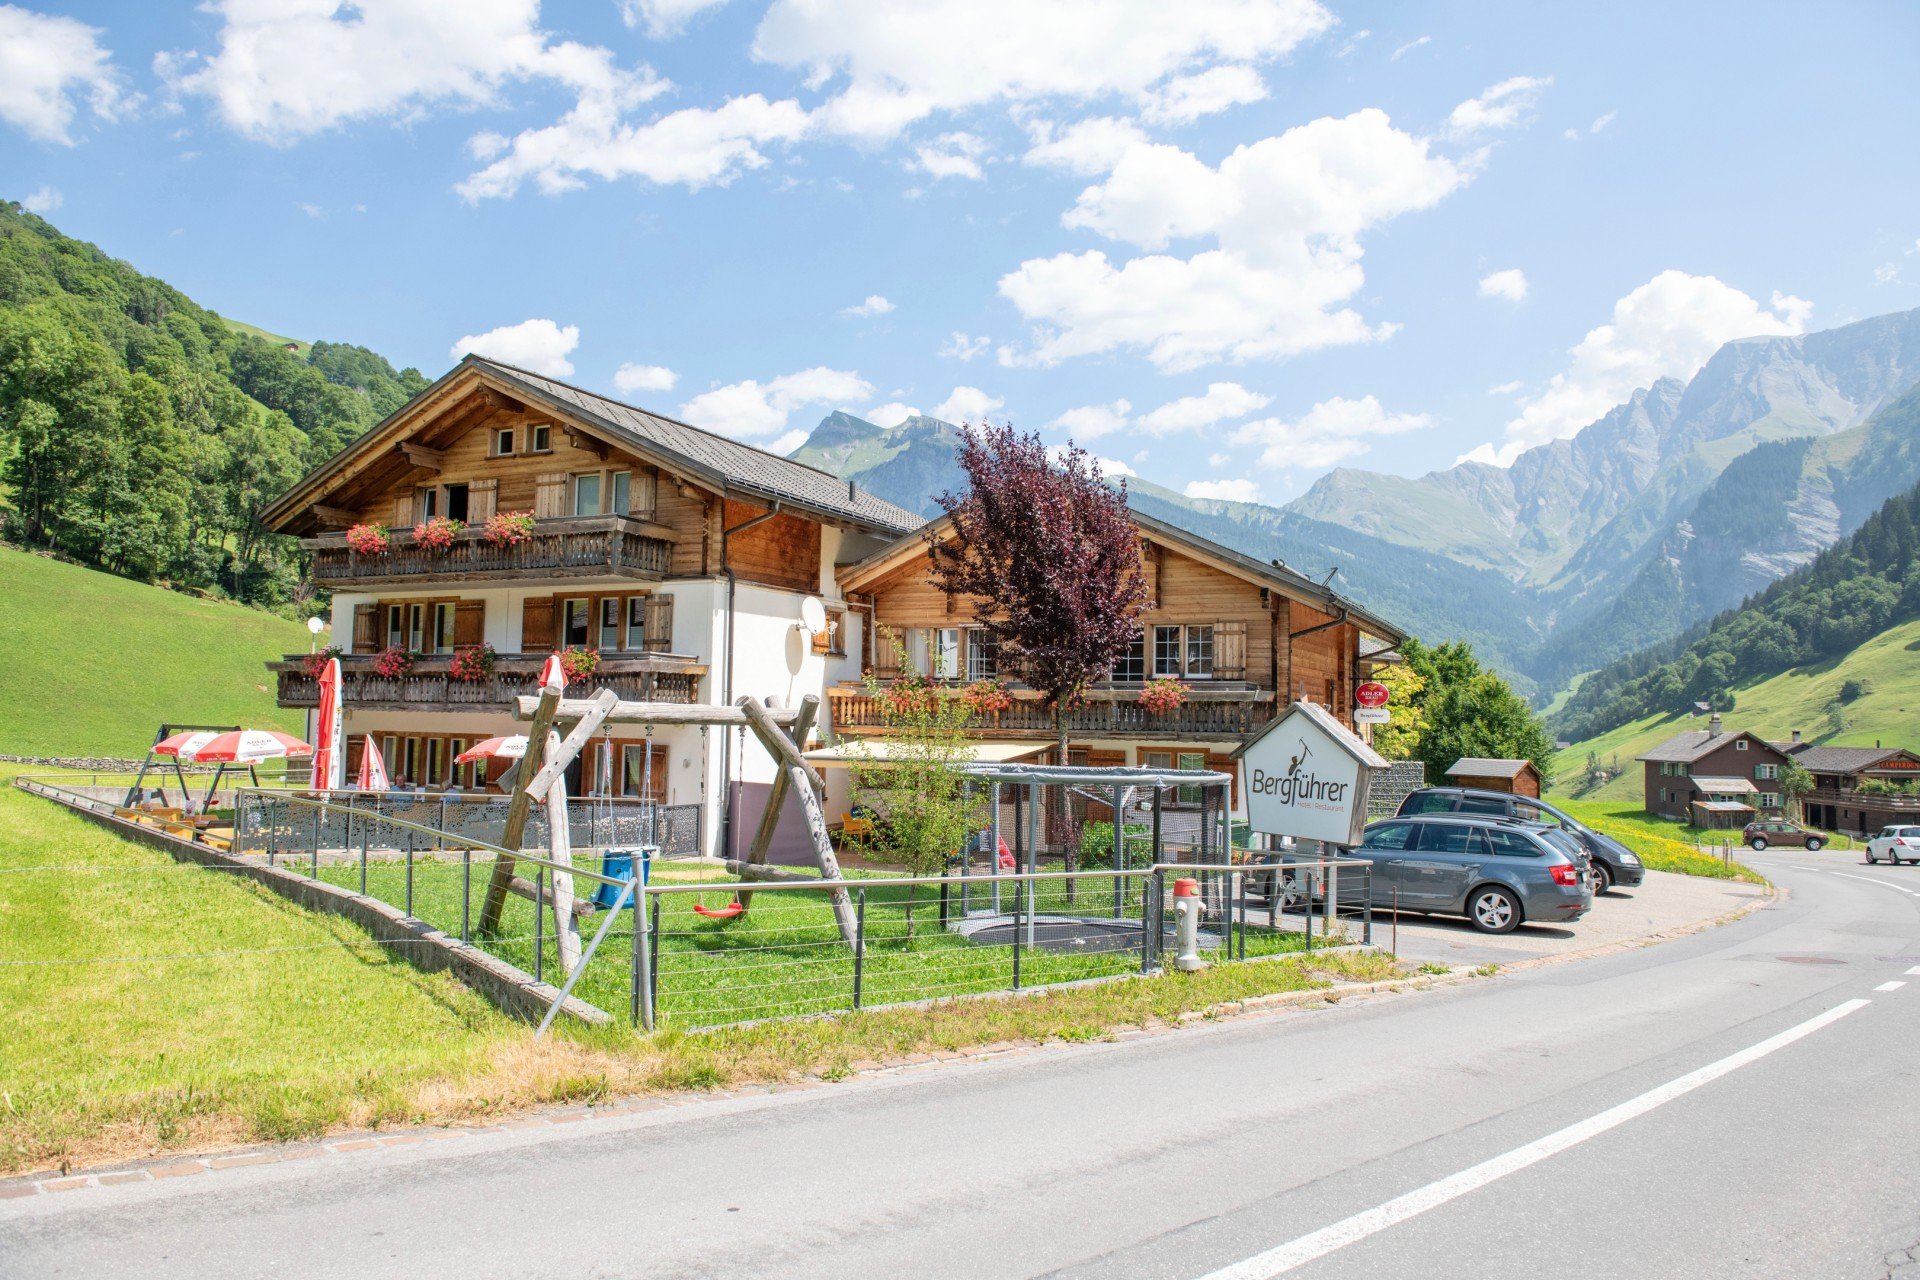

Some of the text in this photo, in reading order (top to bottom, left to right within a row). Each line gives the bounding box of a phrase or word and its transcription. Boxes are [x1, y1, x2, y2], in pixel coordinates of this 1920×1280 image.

[1252, 769, 1348, 807] Bergführer
[1297, 801, 1344, 812] Hotel Restaurant
